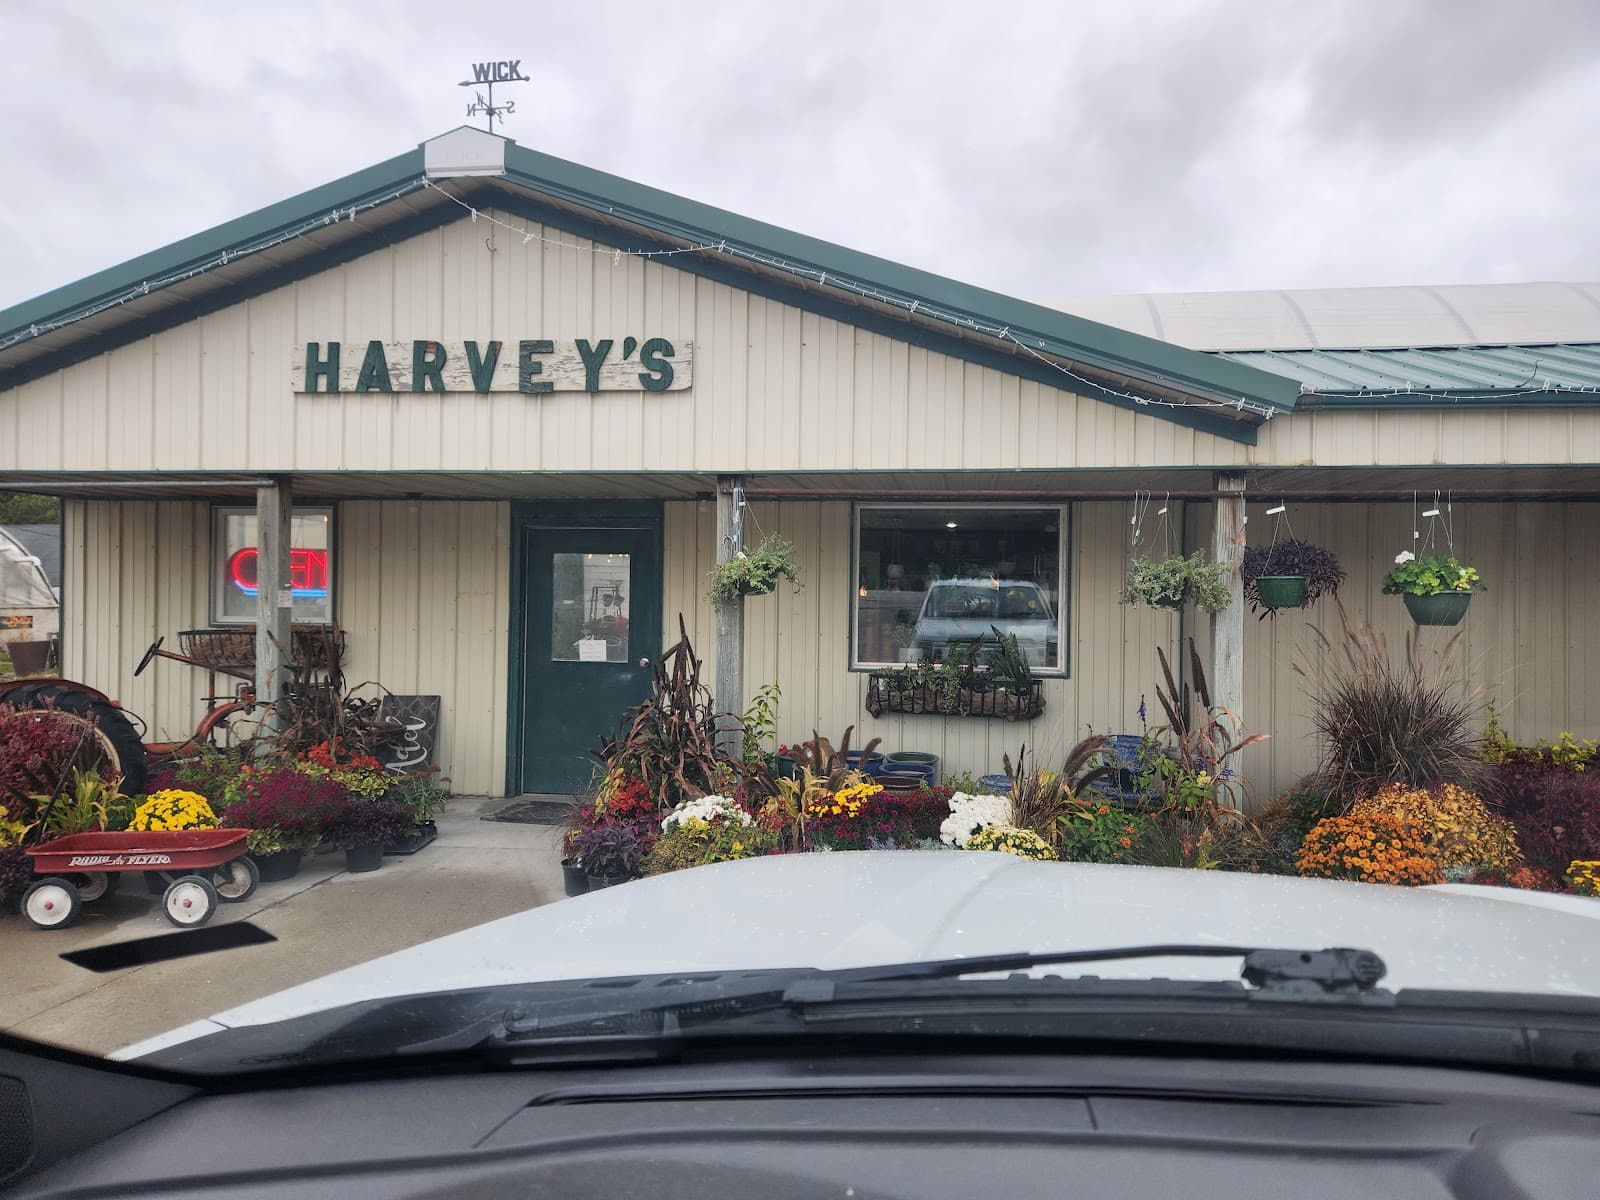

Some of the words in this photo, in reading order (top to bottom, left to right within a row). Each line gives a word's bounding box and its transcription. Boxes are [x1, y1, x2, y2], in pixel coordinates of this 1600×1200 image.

[472, 60, 521, 81] WICK
[305, 336, 675, 394] HARVEY'S
[231, 547, 327, 590] OEN
[127, 854, 171, 866] FLYER
